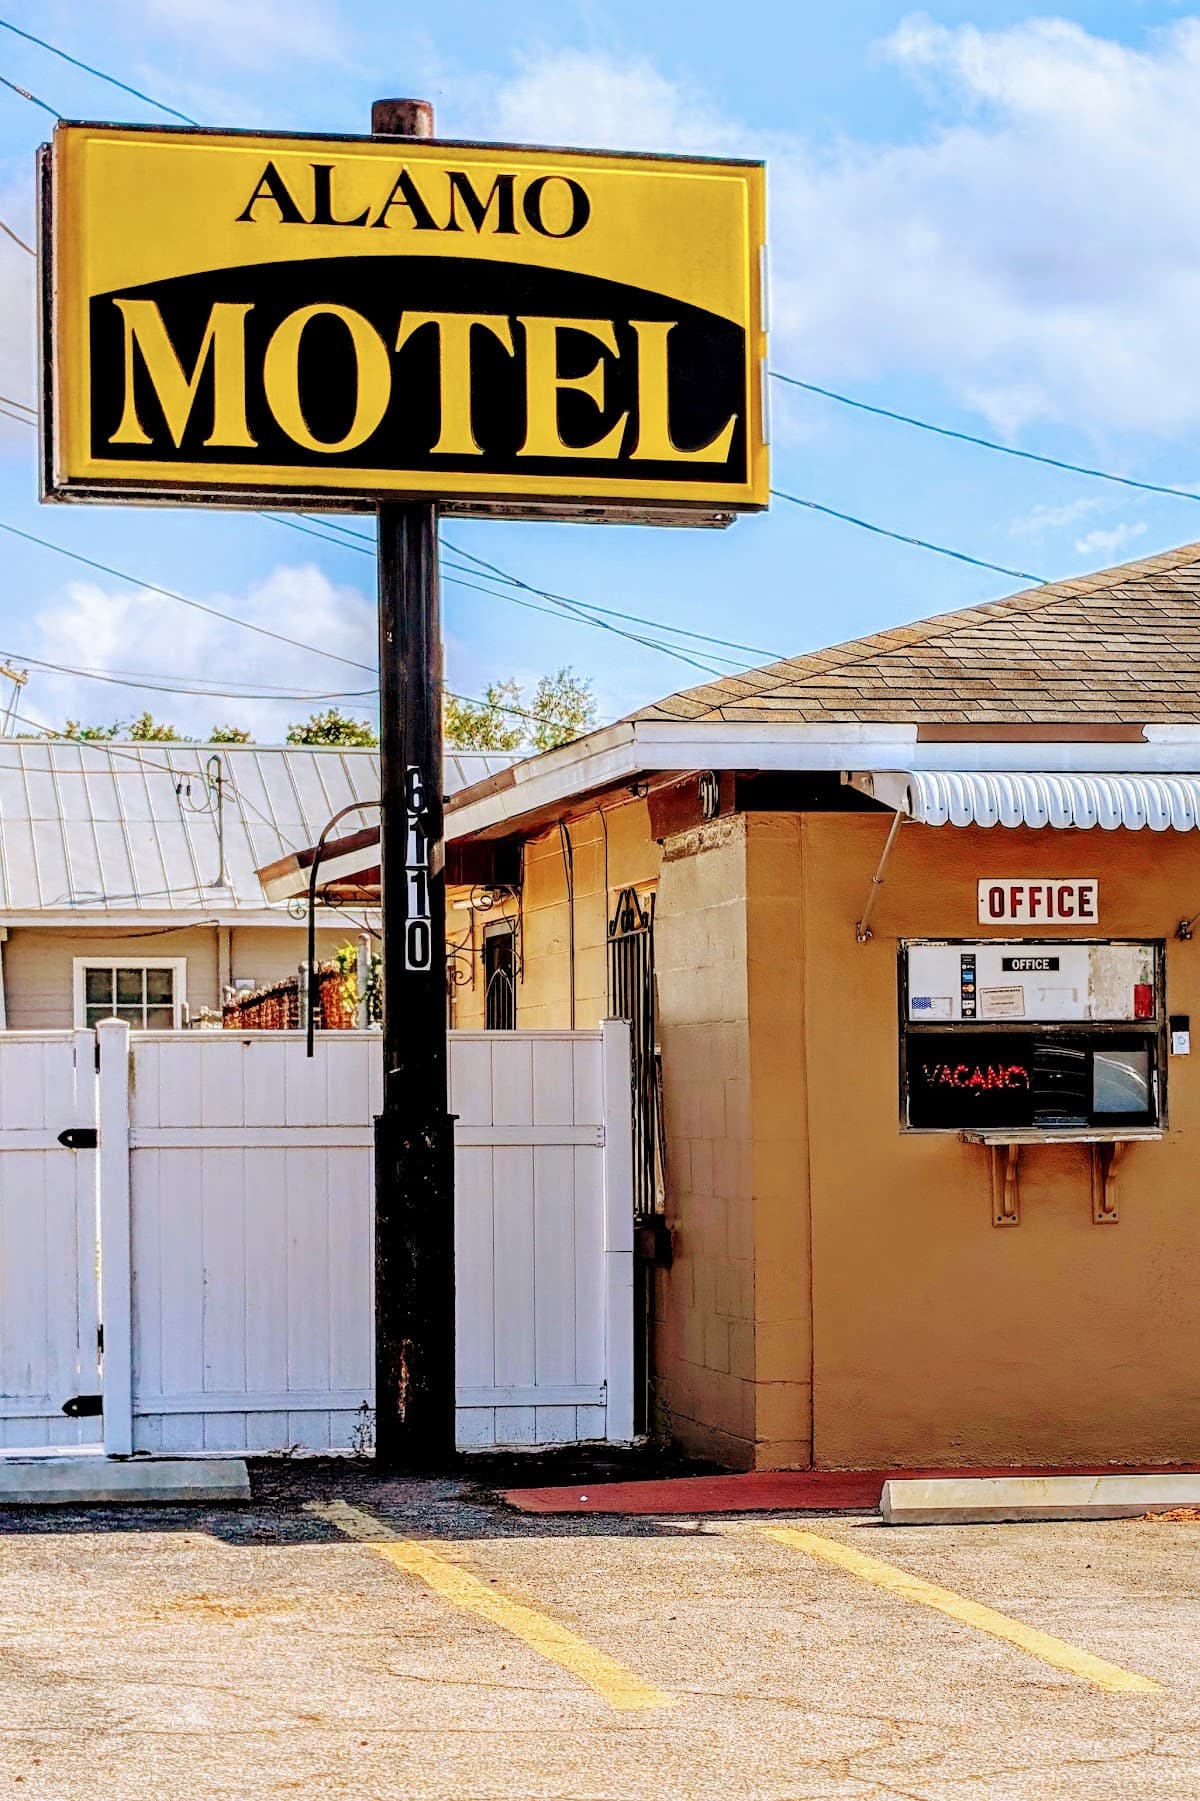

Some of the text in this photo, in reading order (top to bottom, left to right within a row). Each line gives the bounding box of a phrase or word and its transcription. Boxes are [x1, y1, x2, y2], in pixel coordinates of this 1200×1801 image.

[236, 161, 591, 239] ALAMO
[108, 298, 738, 463] MOTEL
[407, 767, 430, 968] 6110
[989, 886, 1094, 918] OFFICE
[1012, 959, 1050, 970] OFFICE
